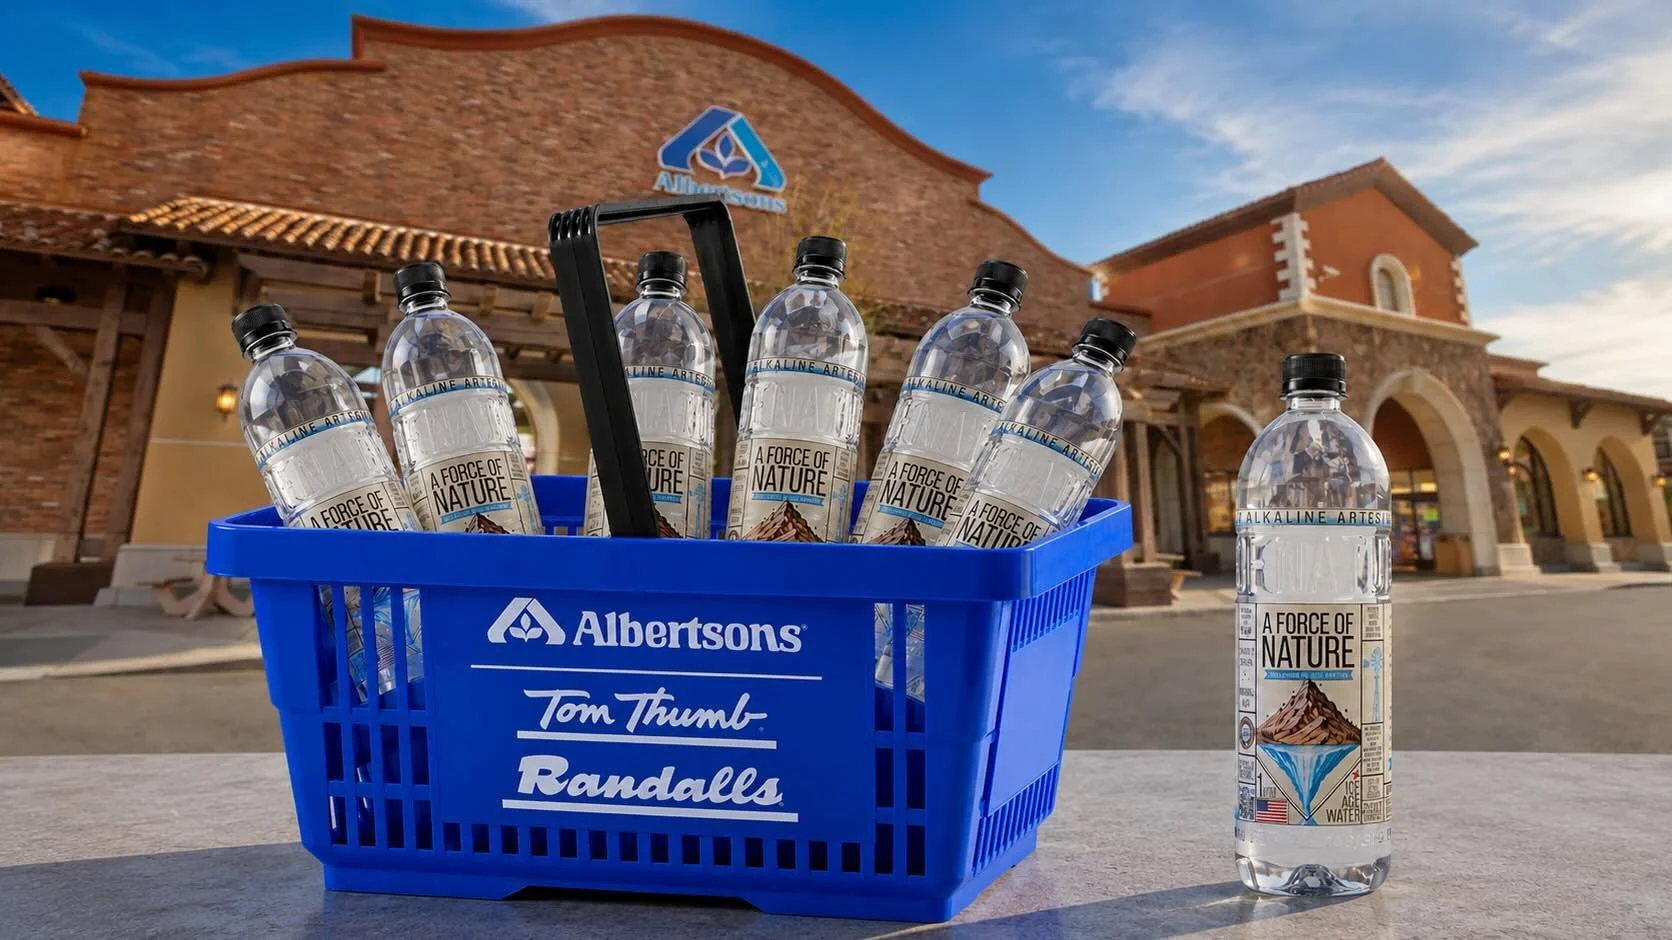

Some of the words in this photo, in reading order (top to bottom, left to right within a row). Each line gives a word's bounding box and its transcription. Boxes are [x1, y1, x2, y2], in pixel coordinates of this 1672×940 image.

[430, 472, 440, 490] A
[440, 460, 487, 487] FORCE
[487, 458, 503, 477] OF
[669, 450, 685, 469] OF
[754, 446, 764, 465] A
[766, 446, 811, 468] FORCE
[813, 450, 831, 470] OF
[648, 467, 684, 495] URE
[751, 465, 828, 497] NATURE
[888, 461, 899, 479] A
[899, 463, 945, 490] FORCE
[945, 475, 965, 495] OF
[320, 496, 369, 529] FORCE
[366, 490, 384, 510] OF
[432, 476, 512, 516] NATURE
[880, 479, 958, 521] NATURE
[956, 516, 1031, 549] NATUR
[968, 500, 981, 517] A
[979, 502, 1025, 534] FORCE
[1022, 521, 1042, 541] OF
[1246, 510, 1327, 525] ALKALINE
[573, 610, 803, 653] Albertsons
[1262, 612, 1272, 634] A
[1276, 612, 1330, 635] FORCE
[1335, 612, 1355, 635] OF
[1262, 635, 1356, 669] NATURE
[523, 688, 615, 731] Tom
[614, 687, 768, 733] Thumb
[517, 754, 784, 806] Randalls
[1345, 781, 1360, 796] ICE
[1326, 809, 1361, 823] WATER
[1341, 796, 1360, 809] AGE
